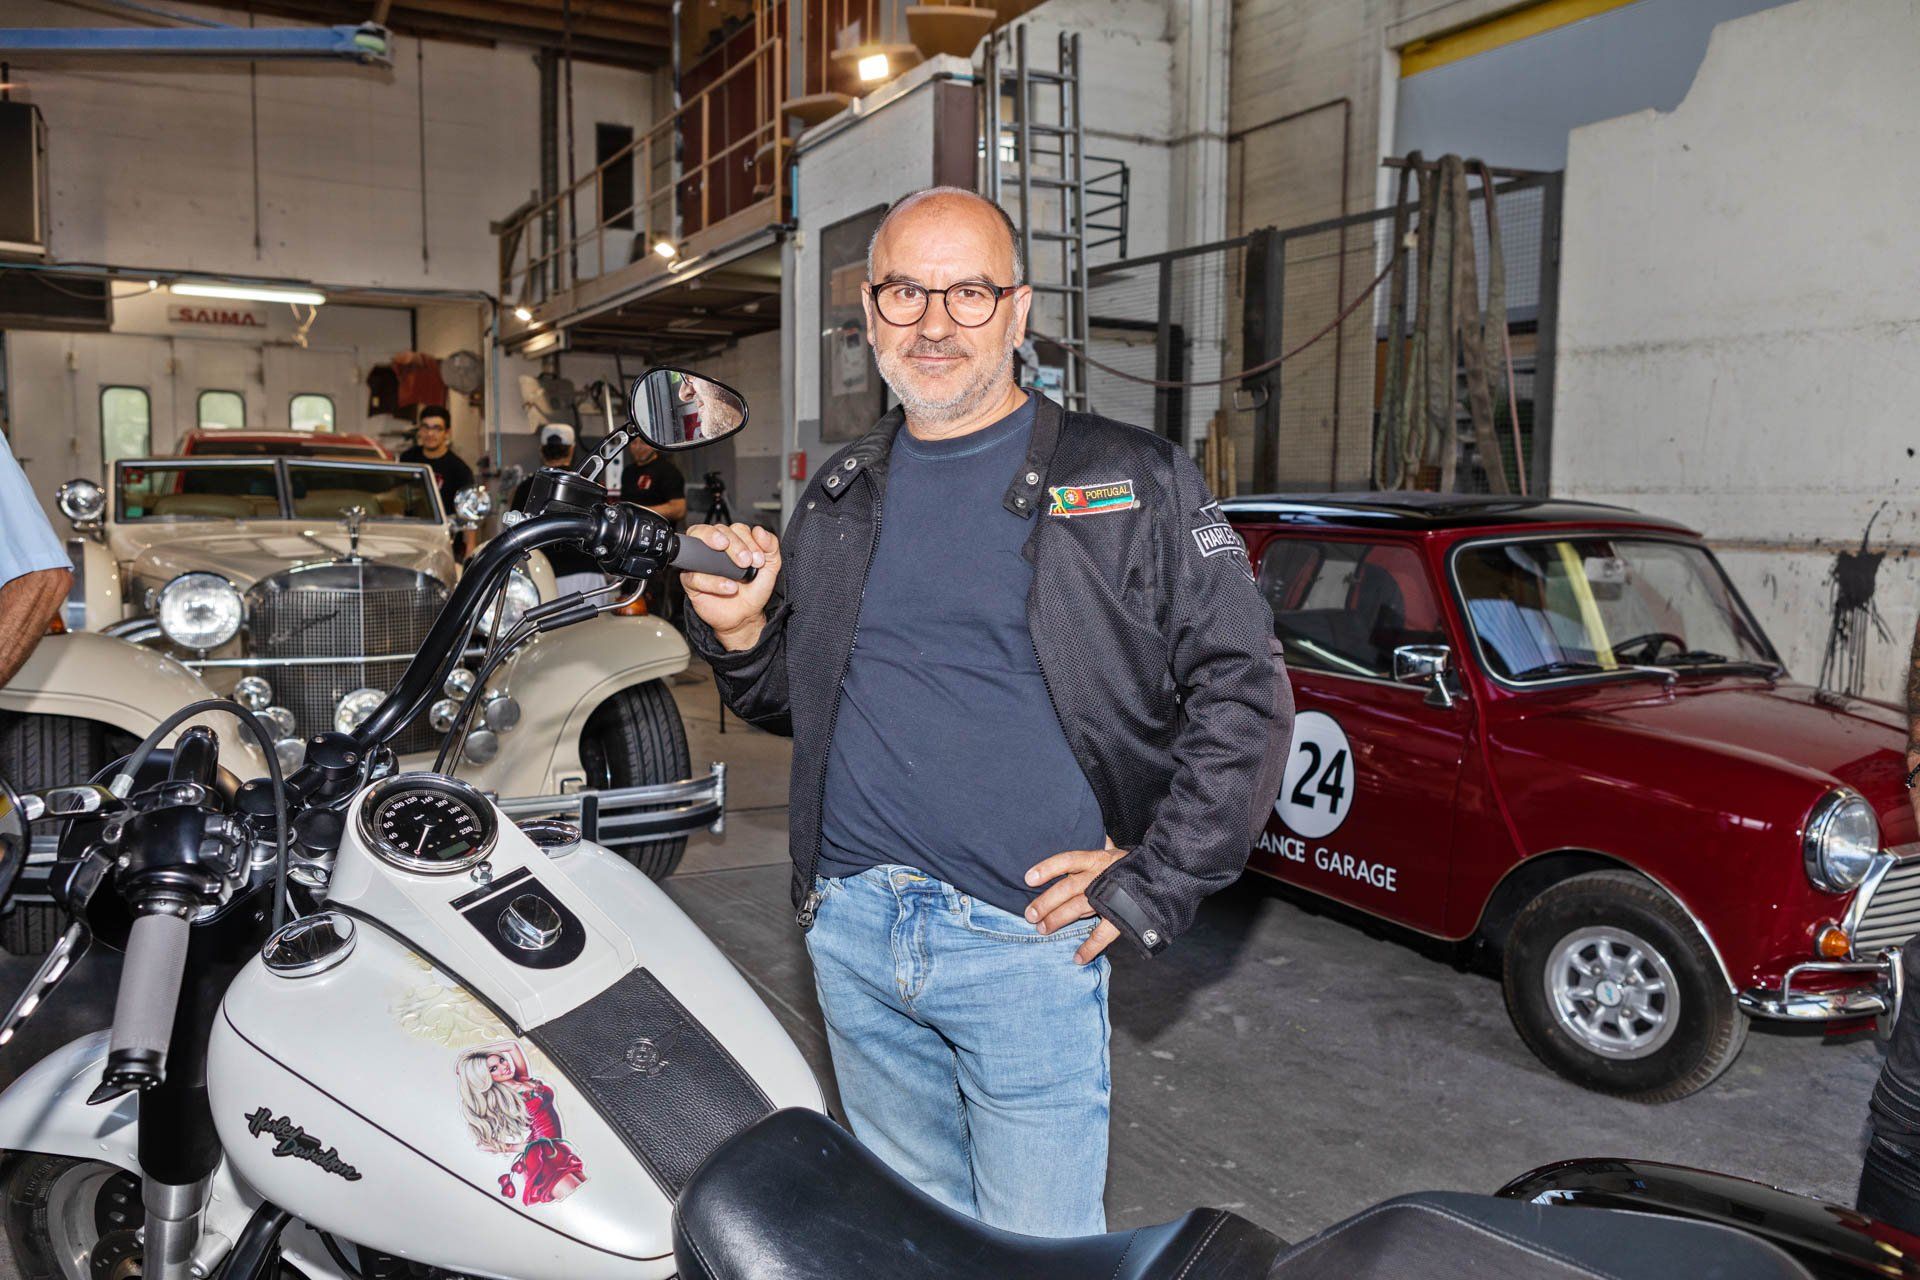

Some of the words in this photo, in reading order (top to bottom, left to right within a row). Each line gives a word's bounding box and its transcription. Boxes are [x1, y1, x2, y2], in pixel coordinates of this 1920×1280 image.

[180, 308, 257, 326] SAIMA
[1085, 484, 1130, 500] PORTUGAL
[1277, 741, 1347, 814] 24
[420, 796, 434, 804] 140
[435, 799, 449, 808] 160
[391, 801, 405, 810] 100
[455, 814, 470, 824] 200
[383, 821, 394, 829] 60
[459, 826, 474, 836] 220
[388, 832, 399, 840] 40
[398, 841, 409, 850] 20
[1255, 830, 1306, 863] ANCE
[1315, 847, 1397, 892] GARAGE
